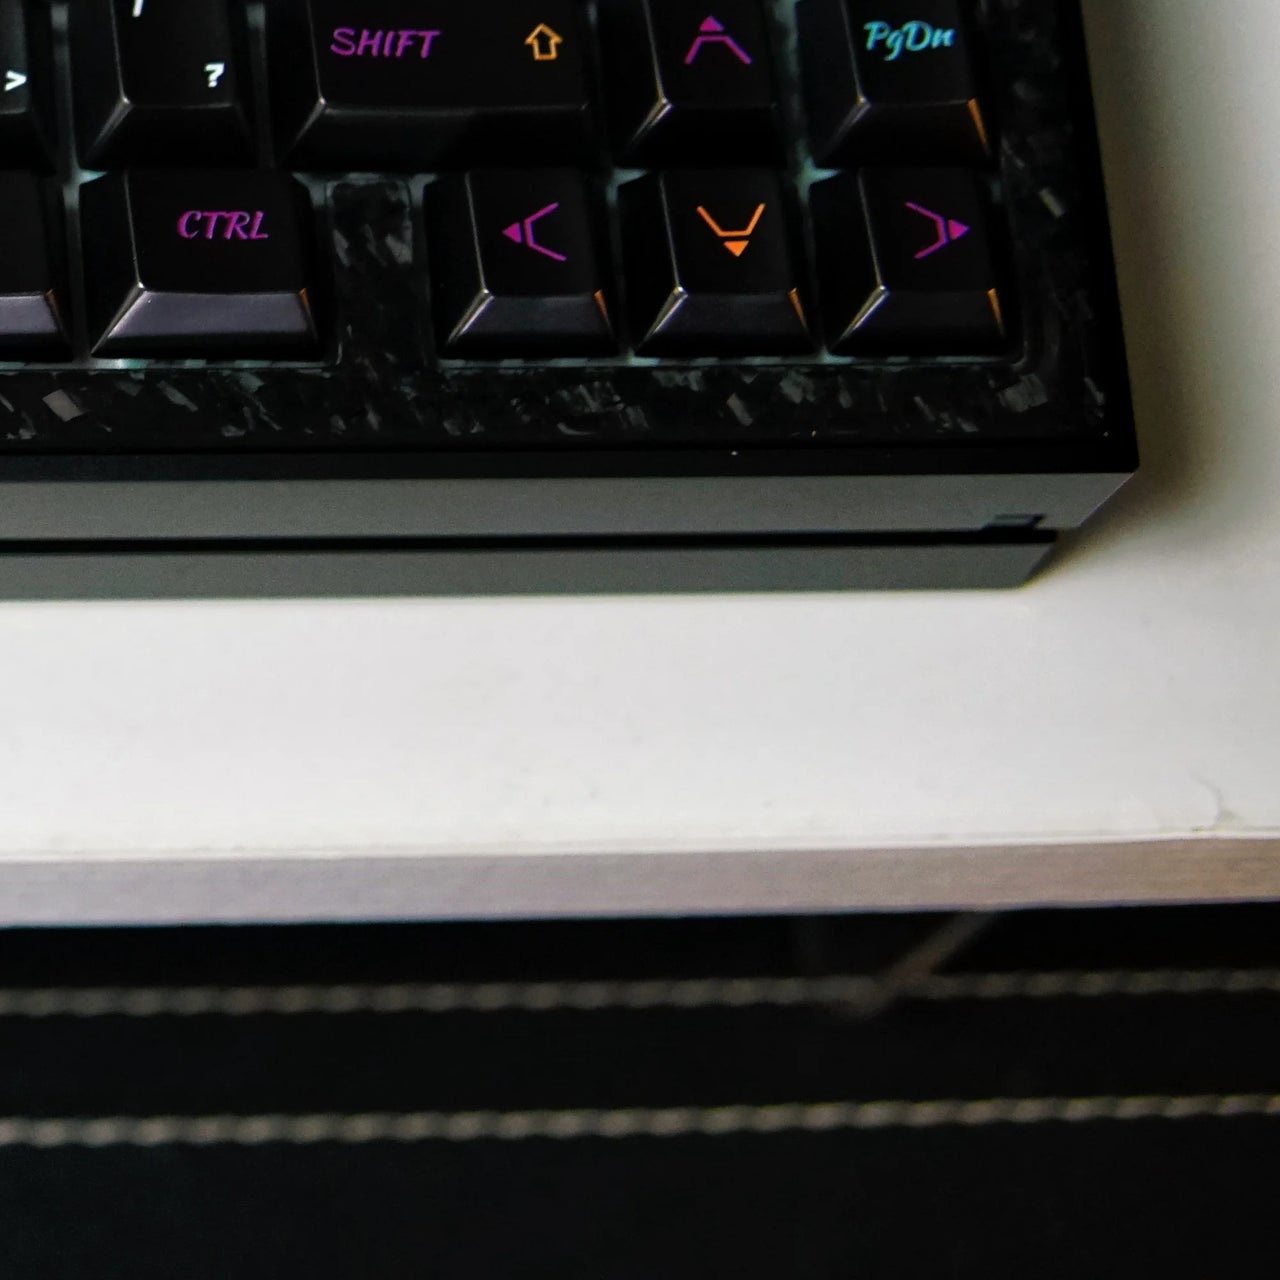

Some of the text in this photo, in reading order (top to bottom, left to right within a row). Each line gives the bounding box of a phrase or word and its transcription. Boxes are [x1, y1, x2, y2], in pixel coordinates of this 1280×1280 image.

[331, 26, 441, 59] SHIFT
[866, 20, 956, 60] PgDn
[205, 62, 225, 88] ?
[177, 210, 267, 240] CTRL
